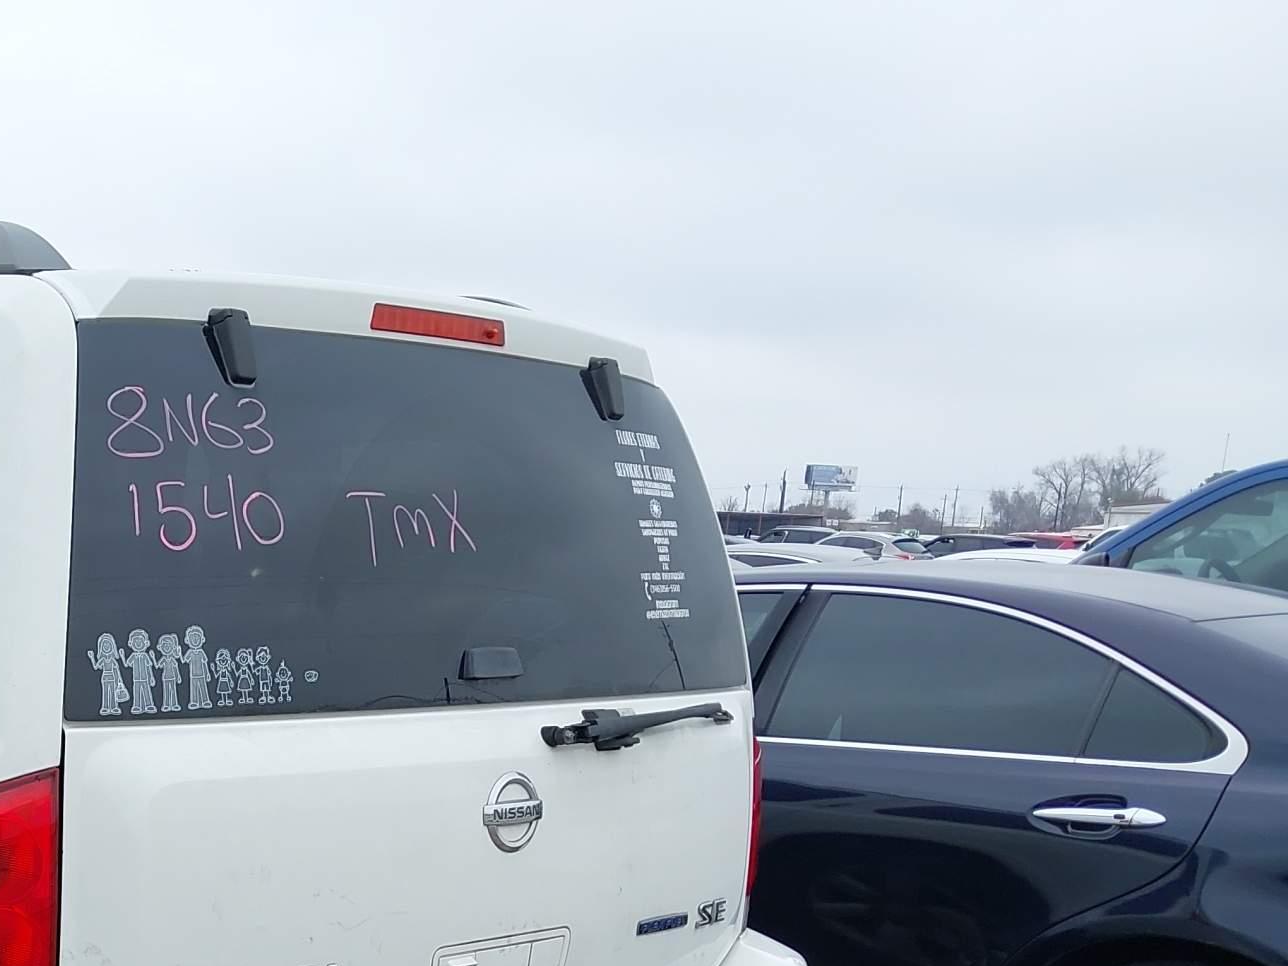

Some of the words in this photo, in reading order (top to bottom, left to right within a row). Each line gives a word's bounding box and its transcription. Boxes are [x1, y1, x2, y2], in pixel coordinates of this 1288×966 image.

[107, 386, 274, 458] 8N63
[129, 474, 284, 551] 1540
[493, 803, 541, 821] NISSAN
[695, 899, 727, 929] SE
